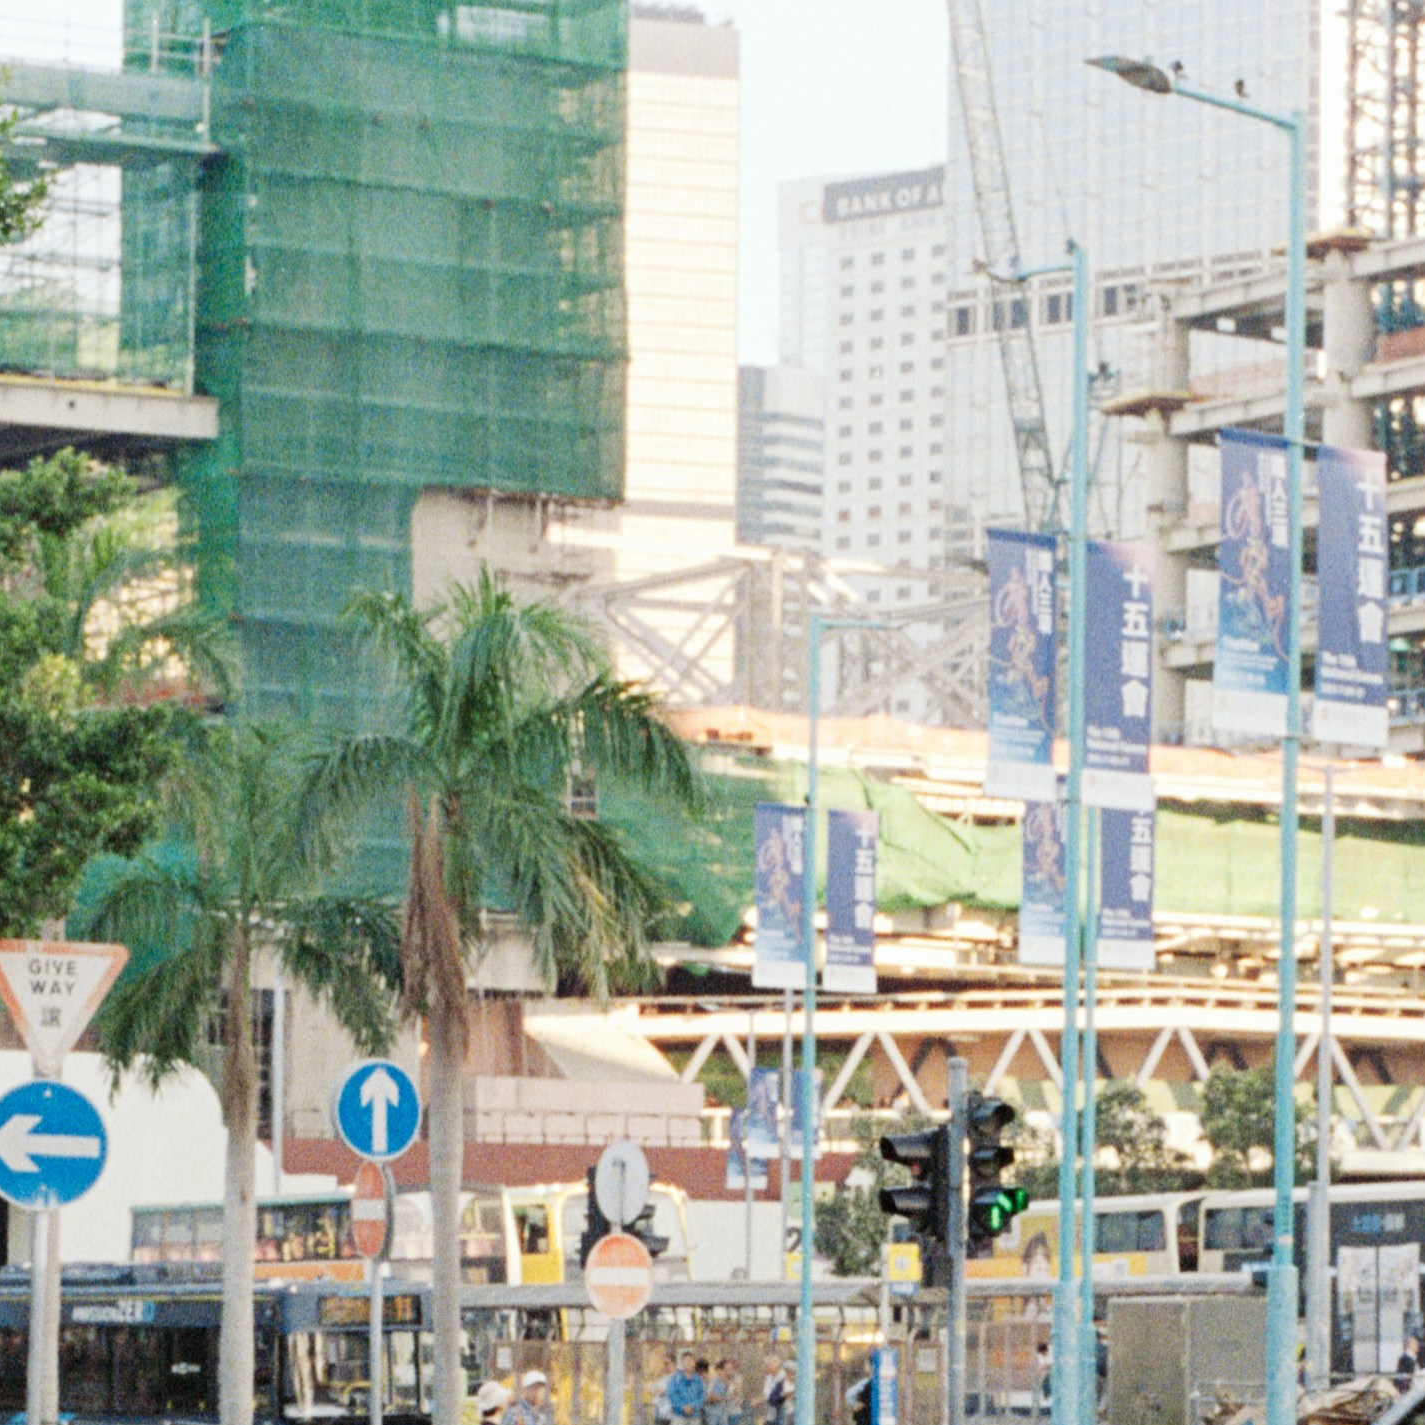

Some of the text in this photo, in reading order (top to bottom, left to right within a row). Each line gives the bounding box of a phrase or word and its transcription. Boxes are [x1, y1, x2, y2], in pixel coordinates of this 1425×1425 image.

[836, 191, 892, 217] BANK
[1356, 472, 1384, 643] 十五運會
[1122, 562, 1150, 716] 十五運會
[1130, 811, 1152, 902] 五運會
[29, 959, 77, 975] GIVE
[31, 980, 75, 995] WAY
